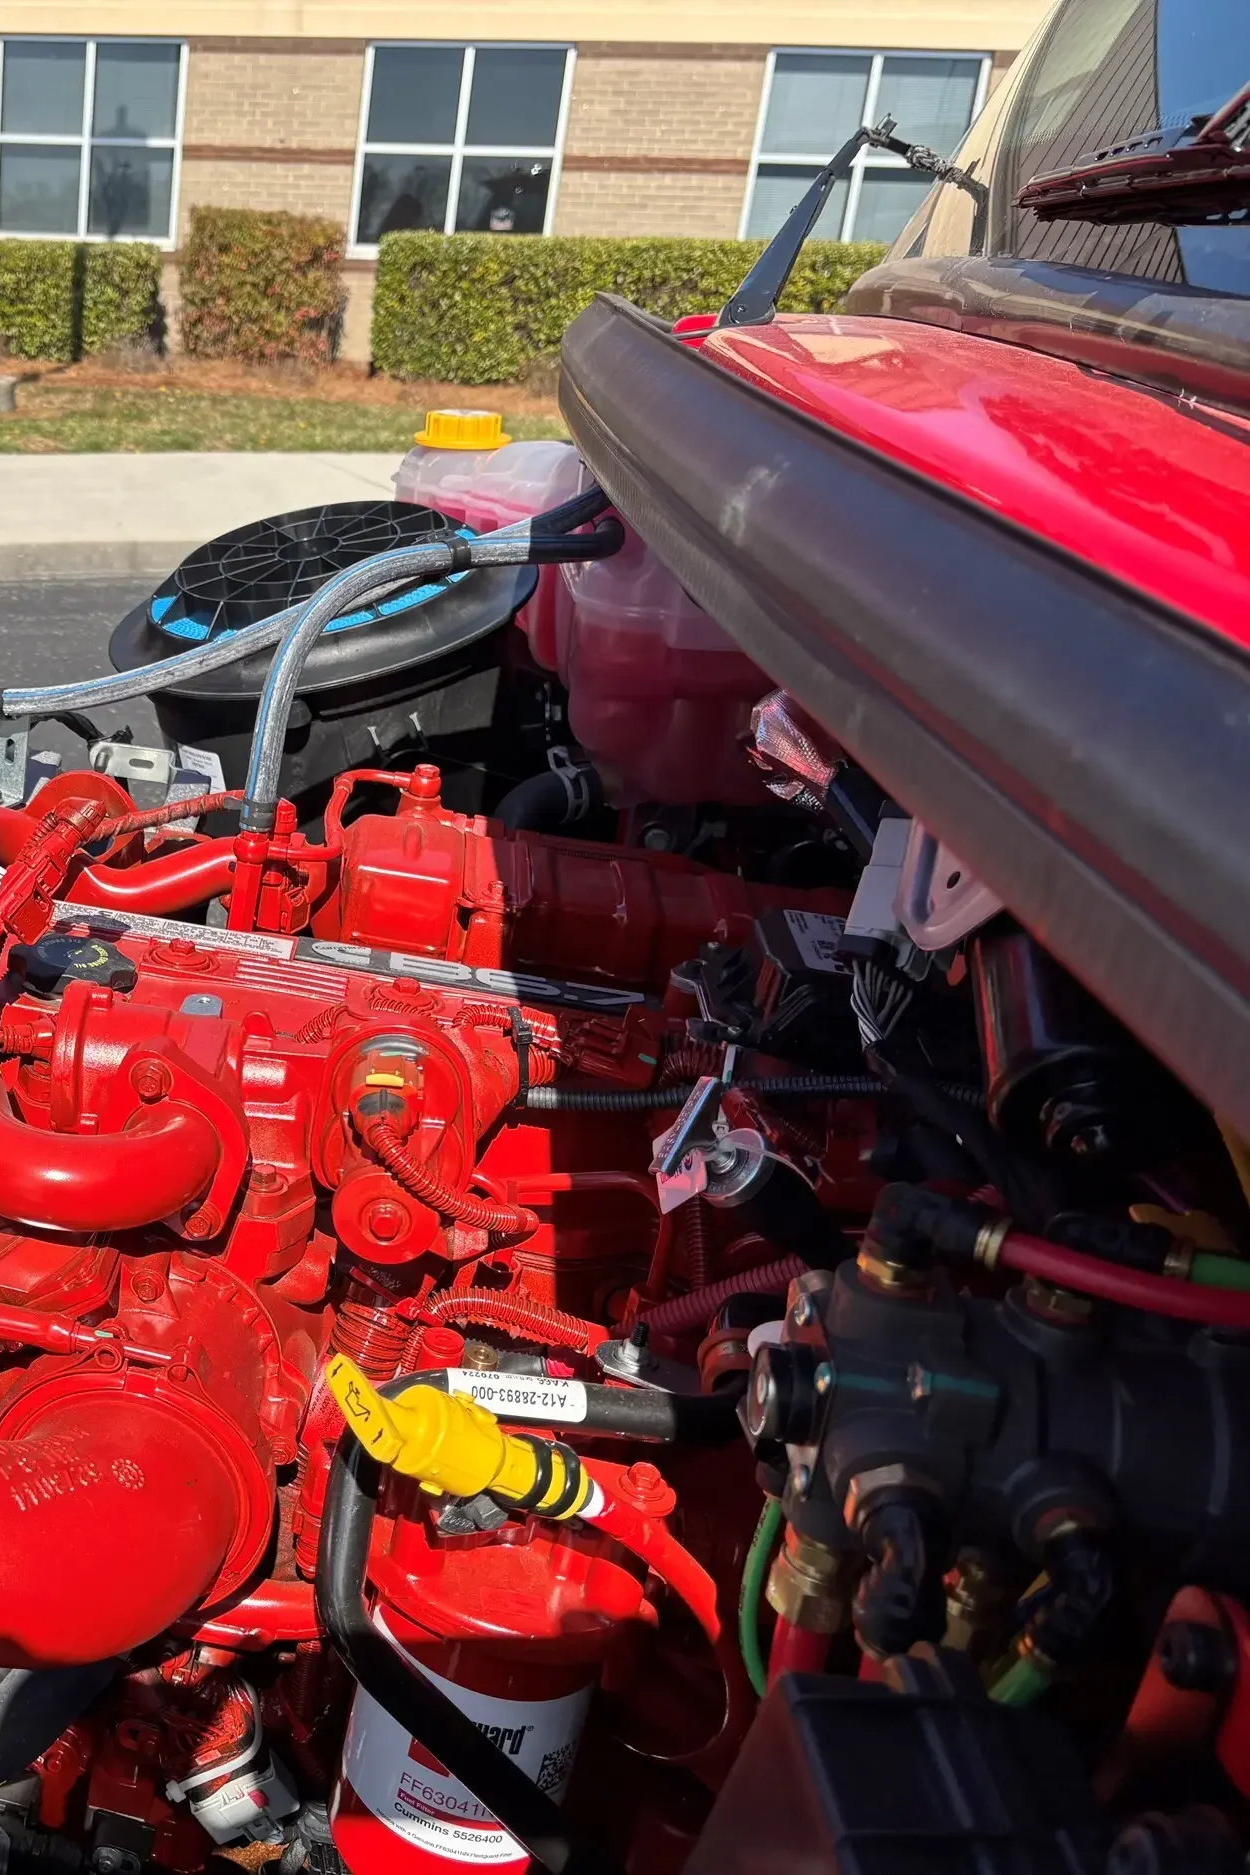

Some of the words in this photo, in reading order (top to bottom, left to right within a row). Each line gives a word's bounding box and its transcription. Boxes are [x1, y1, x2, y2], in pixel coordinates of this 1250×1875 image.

[470, 1385, 568, 1408] A12-28893-000
[400, 1792, 415, 1806] Fuel
[416, 1802, 435, 1816] Filter
[394, 1802, 449, 1836] Cummins
[452, 1830, 503, 1844] 5526400
